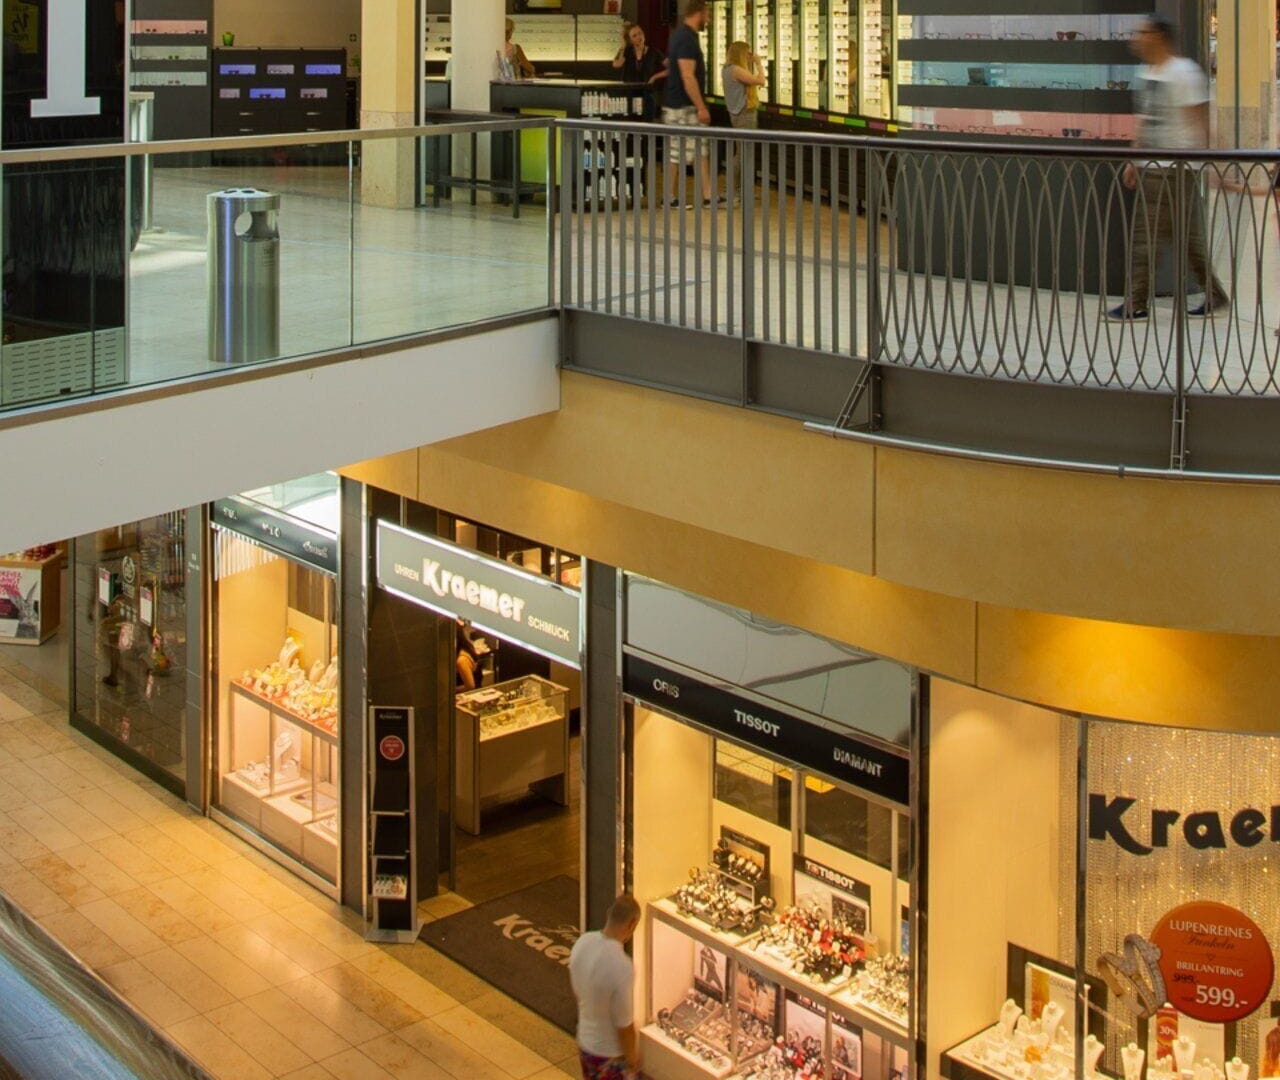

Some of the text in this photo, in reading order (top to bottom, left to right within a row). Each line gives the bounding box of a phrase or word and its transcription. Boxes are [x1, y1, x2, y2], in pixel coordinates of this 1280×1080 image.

[394, 557, 571, 642] UHREN Kraemer SCHMUCK
[733, 708, 781, 737] TISSOT
[832, 746, 883, 778] DIAMANT
[819, 866, 857, 891] TISSOT
[1169, 920, 1253, 939] LUPENREINES
[1176, 961, 1245, 977] BRILLANTRING
[1195, 984, 1249, 1008] 599.-
